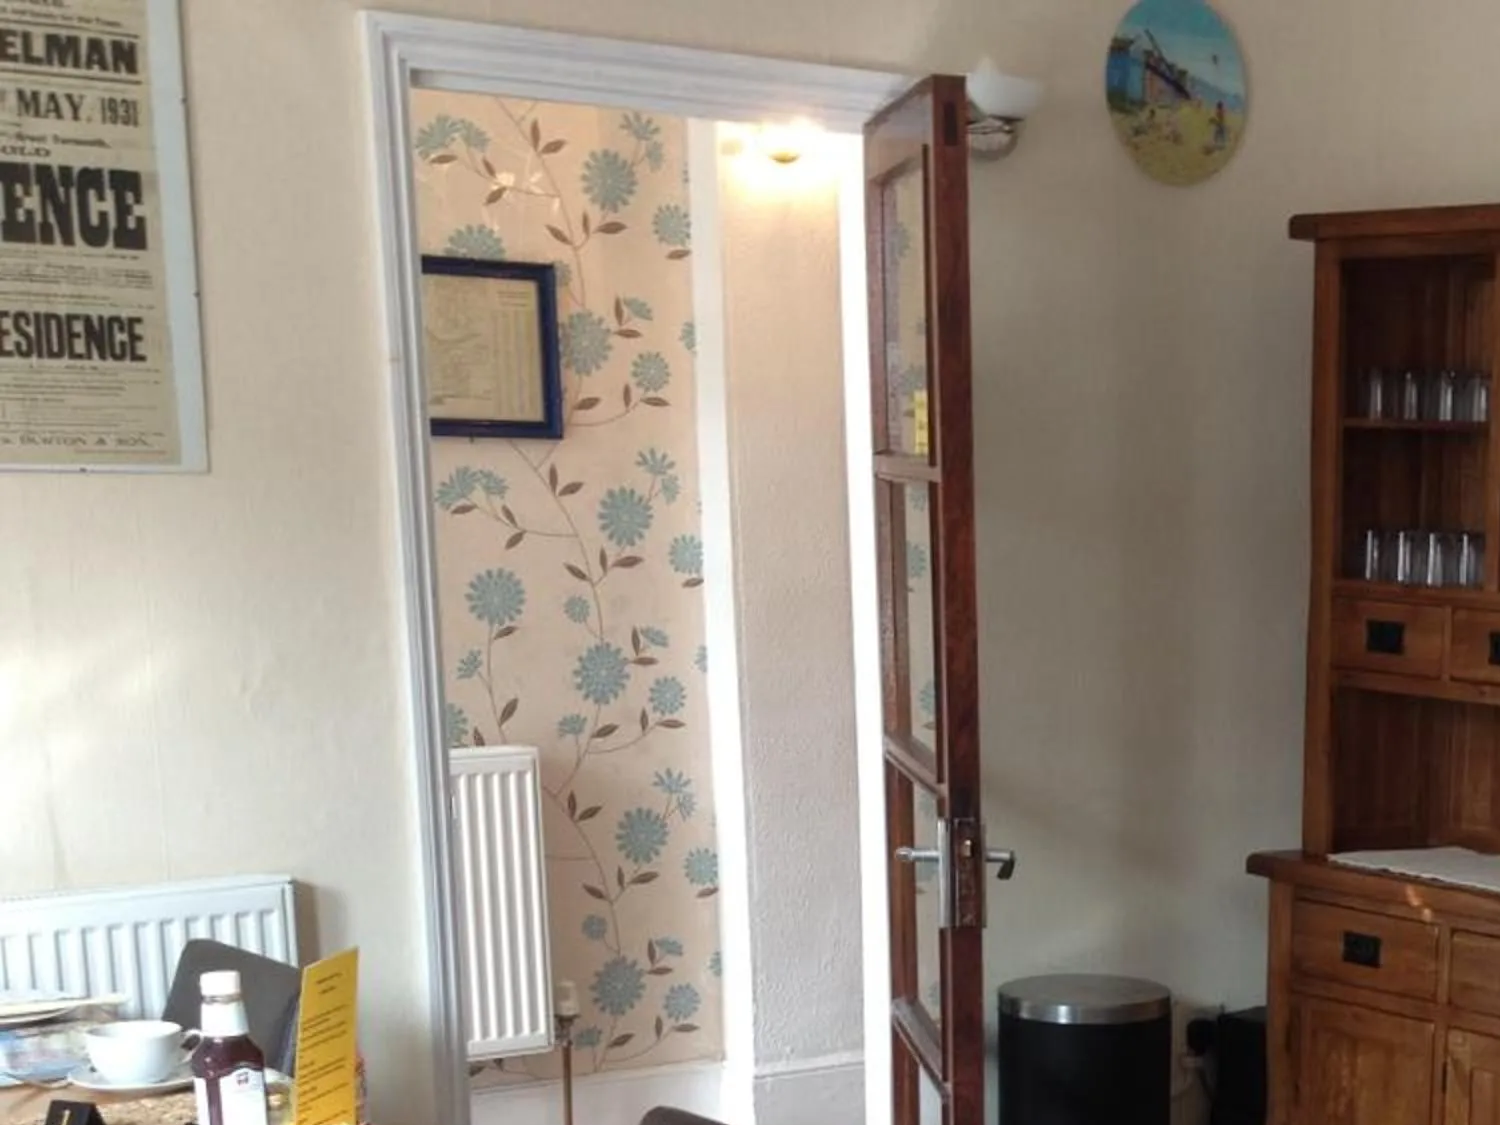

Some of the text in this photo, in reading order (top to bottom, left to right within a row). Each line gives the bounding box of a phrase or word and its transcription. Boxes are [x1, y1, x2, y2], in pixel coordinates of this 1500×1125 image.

[0, 28, 138, 75] ELMAN
[100, 96, 139, 128] 1931
[0, 161, 147, 251] ENCE
[0, 310, 147, 362] ESIDENCE
